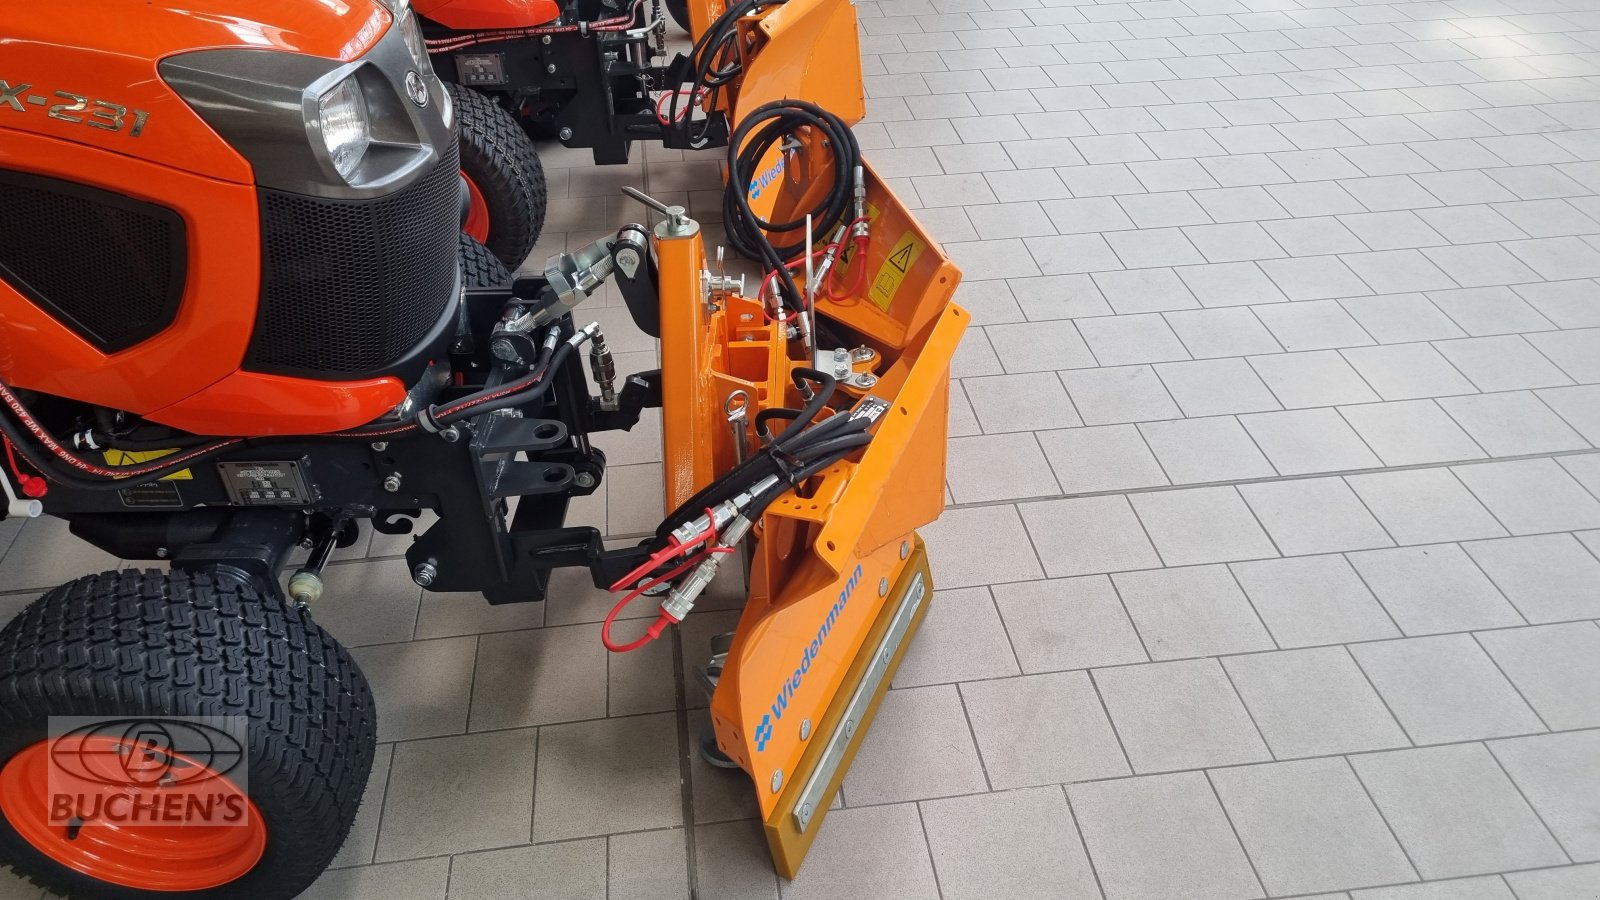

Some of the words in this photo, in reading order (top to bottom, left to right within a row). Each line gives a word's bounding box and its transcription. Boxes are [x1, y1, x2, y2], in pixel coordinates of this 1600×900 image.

[11, 401, 27, 418] 420
[24, 418, 41, 434] WP
[38, 431, 58, 451] MAX
[771, 564, 863, 721] Wiedenmann
